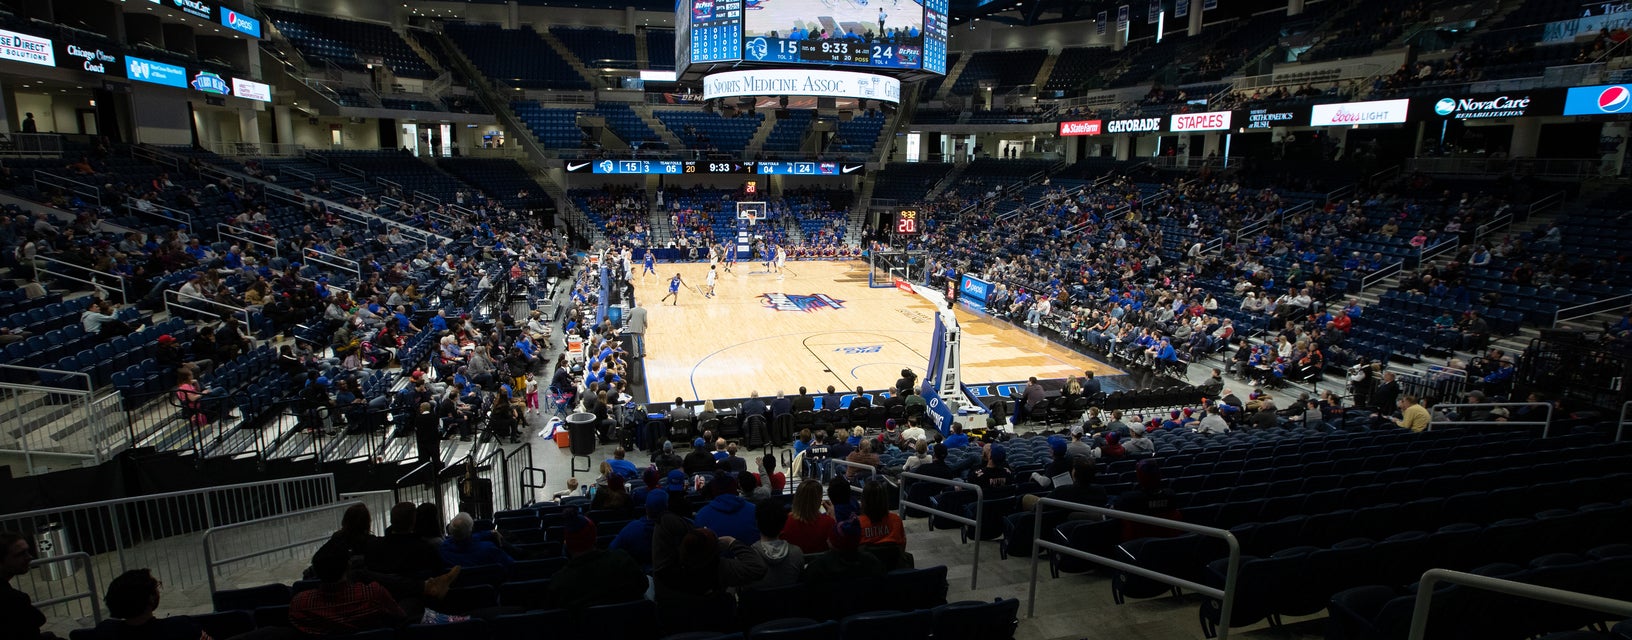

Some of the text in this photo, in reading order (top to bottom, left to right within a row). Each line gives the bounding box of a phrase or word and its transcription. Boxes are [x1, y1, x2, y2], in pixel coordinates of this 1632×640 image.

[67, 45, 96, 60] Chicago
[778, 40, 797, 54] 15
[822, 42, 848, 54] 9:33
[873, 46, 893, 59] 24
[6, 48, 47, 61] SOLUTIONS
[84, 60, 104, 73] Coach
[1455, 95, 1530, 111] NovaCare
[1332, 110, 1389, 123] Coors LIGHT
[1455, 110, 1525, 119] REHABILITATION
[1108, 118, 1161, 133] GATORADE
[1177, 114, 1223, 129] STAPLES
[625, 163, 636, 171] 15
[709, 163, 730, 172] 9:33
[800, 164, 810, 172] 24
[899, 219, 914, 232] 20
[865, 526, 890, 538] DITKA
